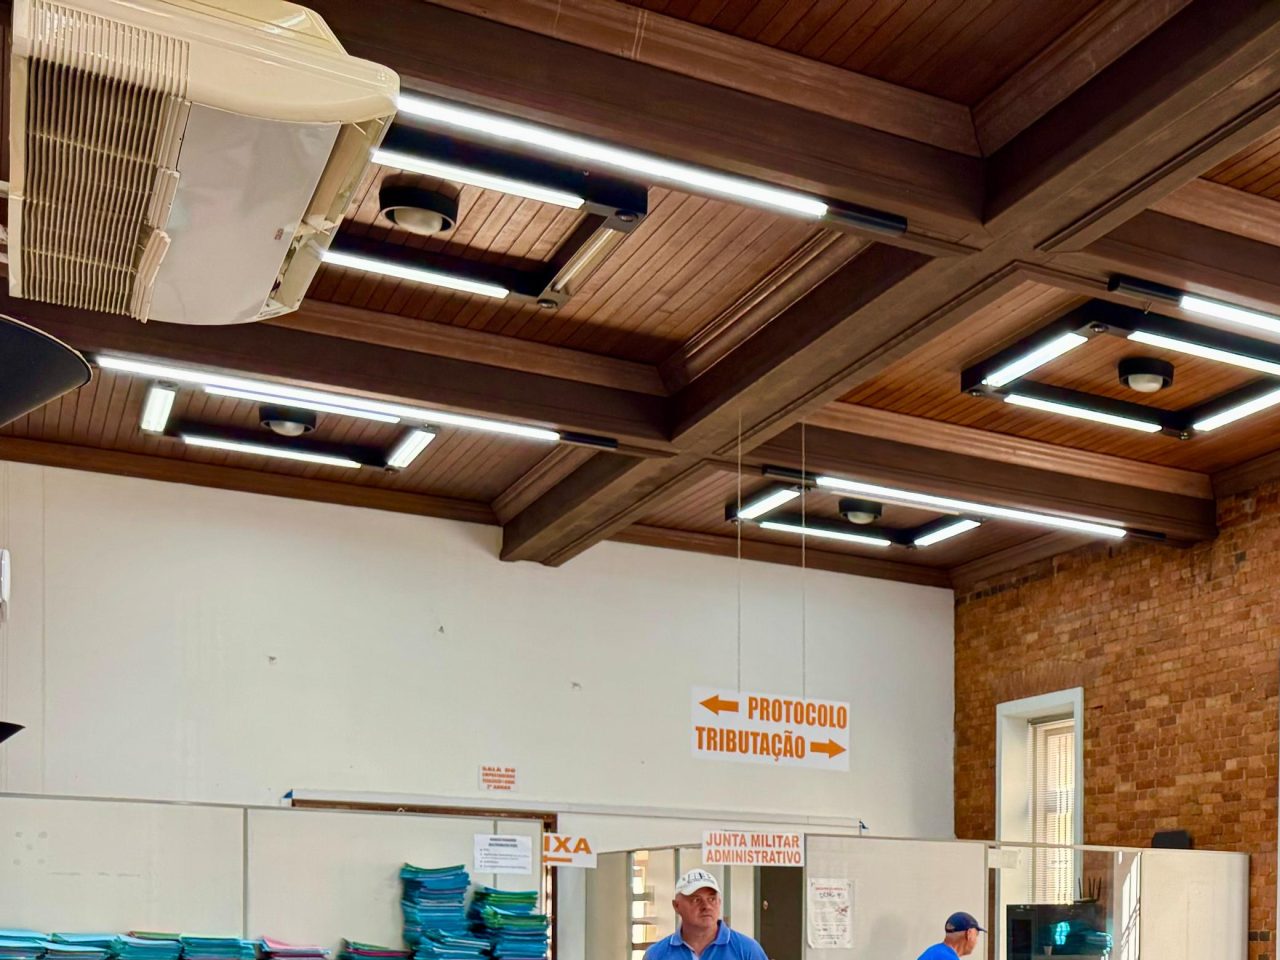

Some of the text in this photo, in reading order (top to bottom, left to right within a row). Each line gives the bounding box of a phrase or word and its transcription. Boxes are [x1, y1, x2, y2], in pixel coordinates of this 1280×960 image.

[748, 696, 848, 730] PROTOCOLO
[695, 726, 805, 762] TRIBUTAÇÃO
[543, 835, 592, 854] IXA
[706, 833, 800, 848] JUNTA MILITAR
[706, 850, 801, 865] ADMINISTRATIVO
